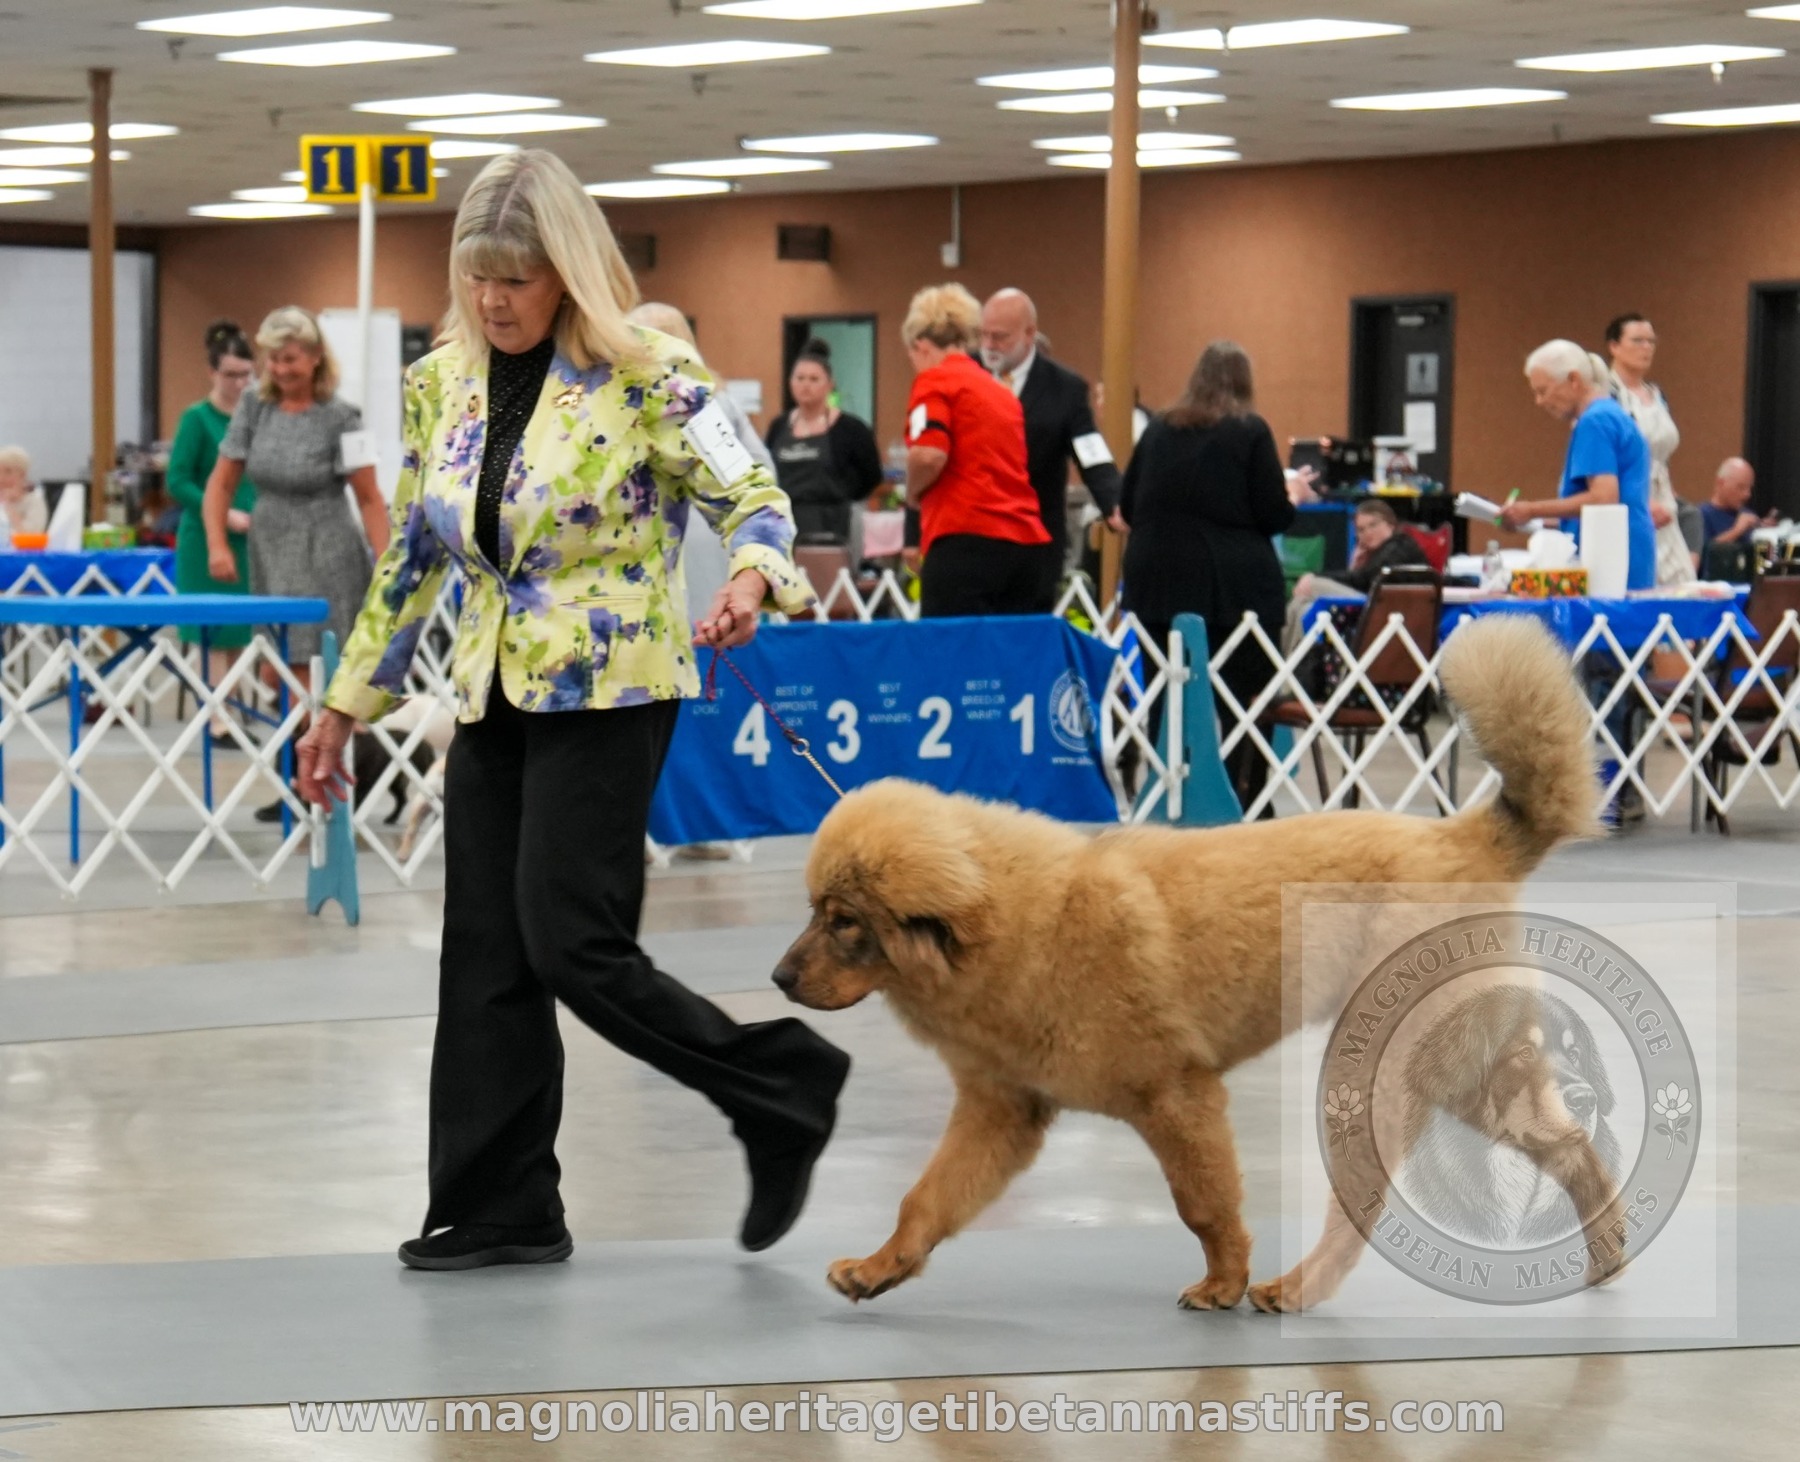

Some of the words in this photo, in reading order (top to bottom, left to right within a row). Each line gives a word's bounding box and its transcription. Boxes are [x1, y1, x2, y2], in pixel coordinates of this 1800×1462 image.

[321, 147, 345, 193] 1
[392, 147, 416, 193] 1
[775, 686, 798, 697] BEST
[801, 685, 815, 696] OF
[879, 682, 901, 694] BEST
[965, 679, 988, 691] BEST
[883, 697, 897, 708] OF
[966, 708, 1001, 720] VARIETY
[826, 699, 861, 764] 3
[868, 712, 913, 724] WINNERS
[918, 696, 952, 760] 2
[1010, 693, 1034, 755] 1
[733, 701, 771, 766] 4
